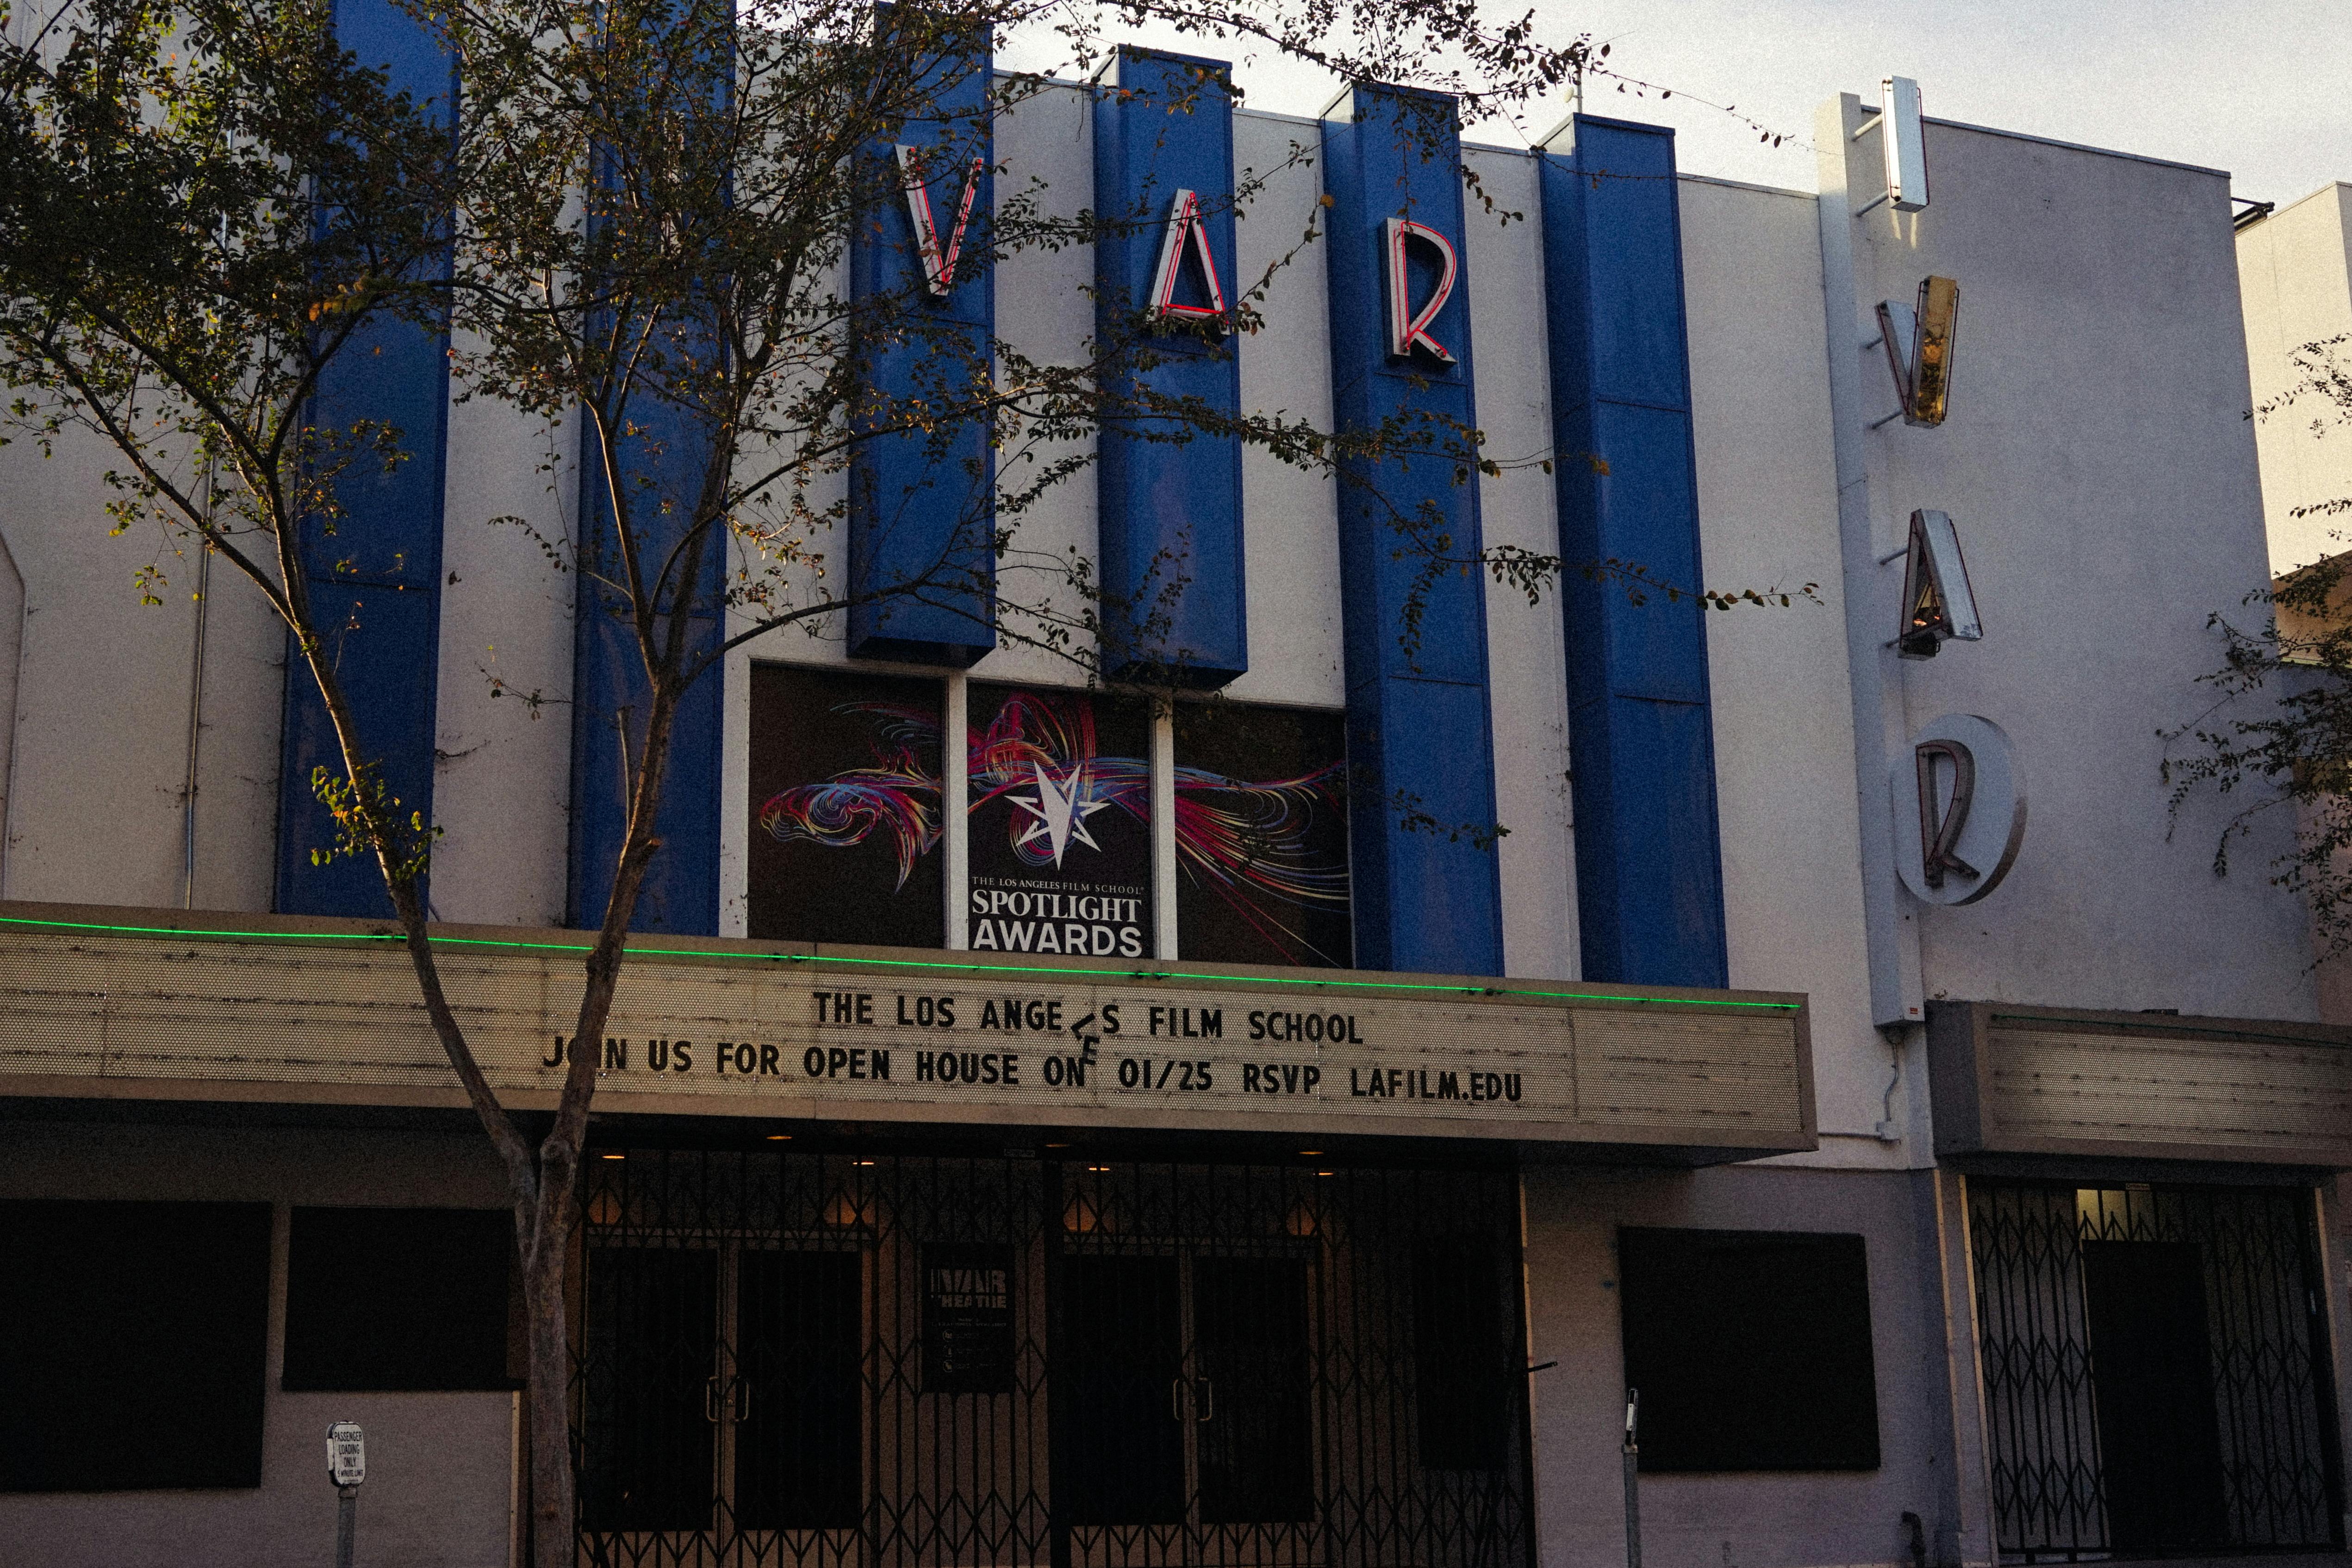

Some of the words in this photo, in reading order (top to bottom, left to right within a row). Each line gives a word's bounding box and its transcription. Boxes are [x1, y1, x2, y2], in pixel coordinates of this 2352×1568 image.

[972, 877, 995, 885] THE
[999, 878, 1017, 887] LOS
[1019, 880, 1060, 890] ANGELES
[1063, 882, 1089, 891] FILM
[972, 890, 1142, 922] SPOTLIGHT
[973, 919, 1143, 958] AWARDS
[813, 991, 873, 1024] THE
[897, 996, 955, 1028] LOS
[1150, 1006, 1223, 1038] FILM
[1249, 1011, 1363, 1045] SCHOOL
[543, 1036, 627, 1070] JN
[648, 1040, 691, 1072] US
[717, 1043, 780, 1075] FOR
[804, 1047, 890, 1080] OPEN
[916, 1051, 1019, 1084] HOUSE
[1043, 1056, 1085, 1087] ON
[1243, 1063, 1320, 1094] RSVP
[1351, 1068, 1522, 1101] LAFILM.EDU
[334, 1431, 362, 1442] PASSENGER
[339, 1444, 360, 1455] LOADING
[344, 1457, 356, 1468] ONLY
